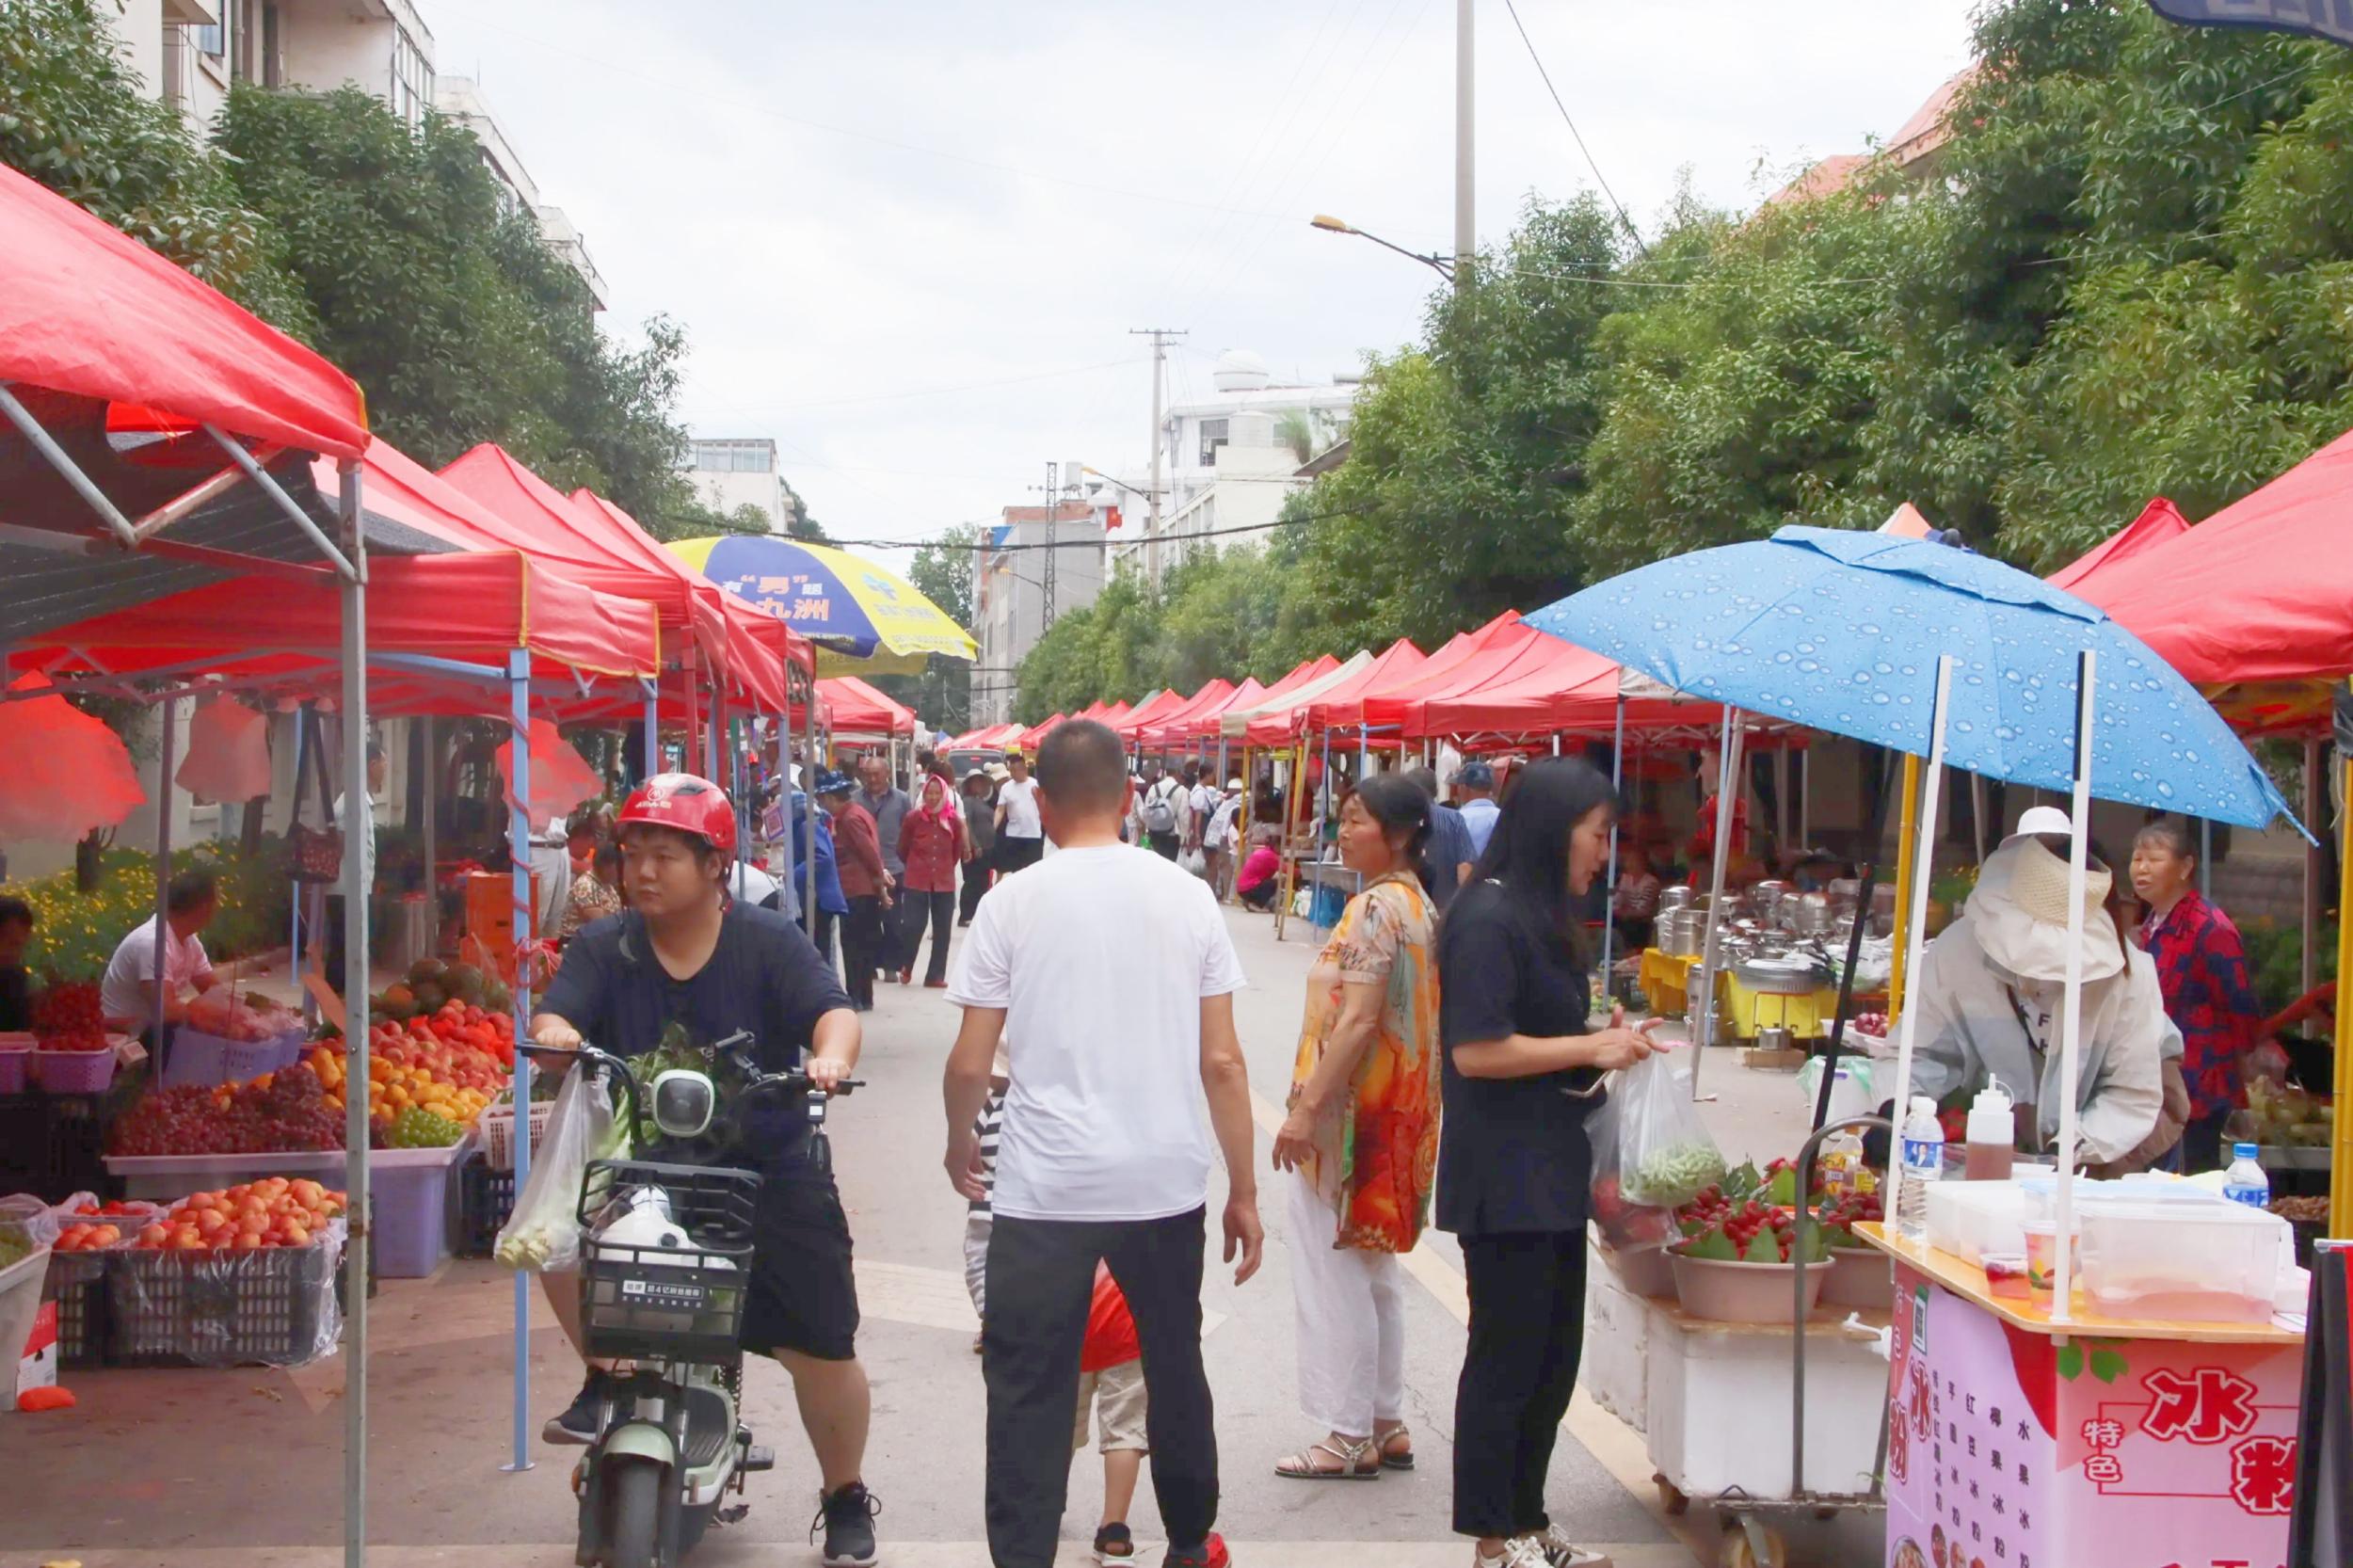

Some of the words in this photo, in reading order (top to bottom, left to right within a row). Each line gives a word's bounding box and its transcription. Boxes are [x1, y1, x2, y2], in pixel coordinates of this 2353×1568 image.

[1965, 1393, 1980, 1543] 红豆冰粉
[1990, 1406, 2005, 1559] 椰果冰粉
[2018, 1419, 2030, 1568] 水果冰粉
[2081, 1419, 2124, 1483] 特色
